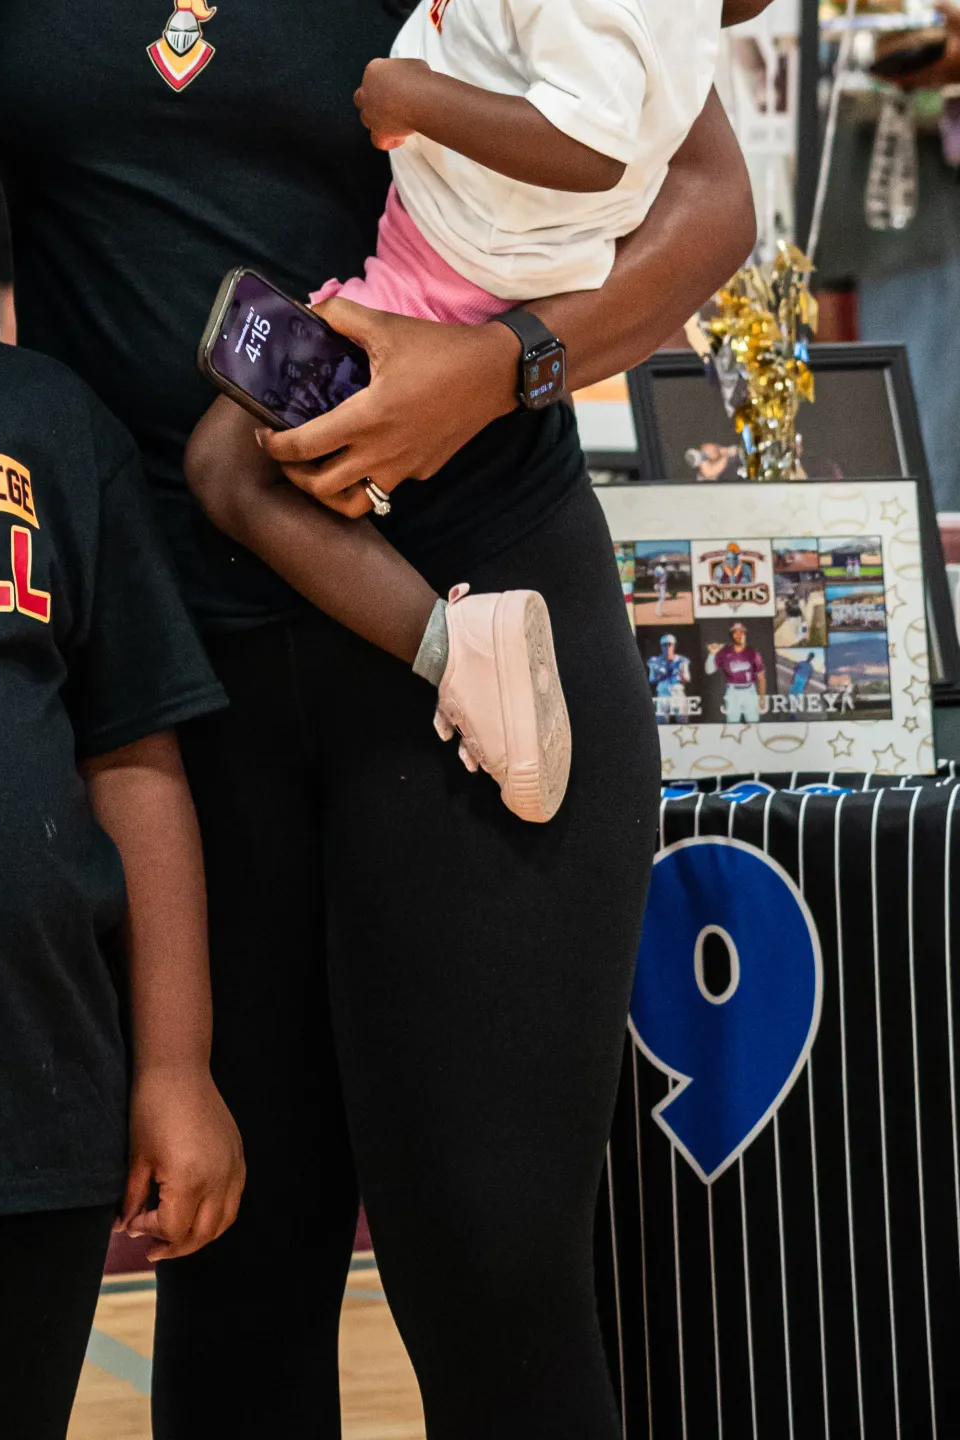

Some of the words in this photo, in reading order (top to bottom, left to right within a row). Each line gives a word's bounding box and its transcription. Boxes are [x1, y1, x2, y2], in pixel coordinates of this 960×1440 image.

[245, 315, 271, 363] 4:15
[652, 695, 702, 716] THE
[628, 835, 824, 1185] 9
